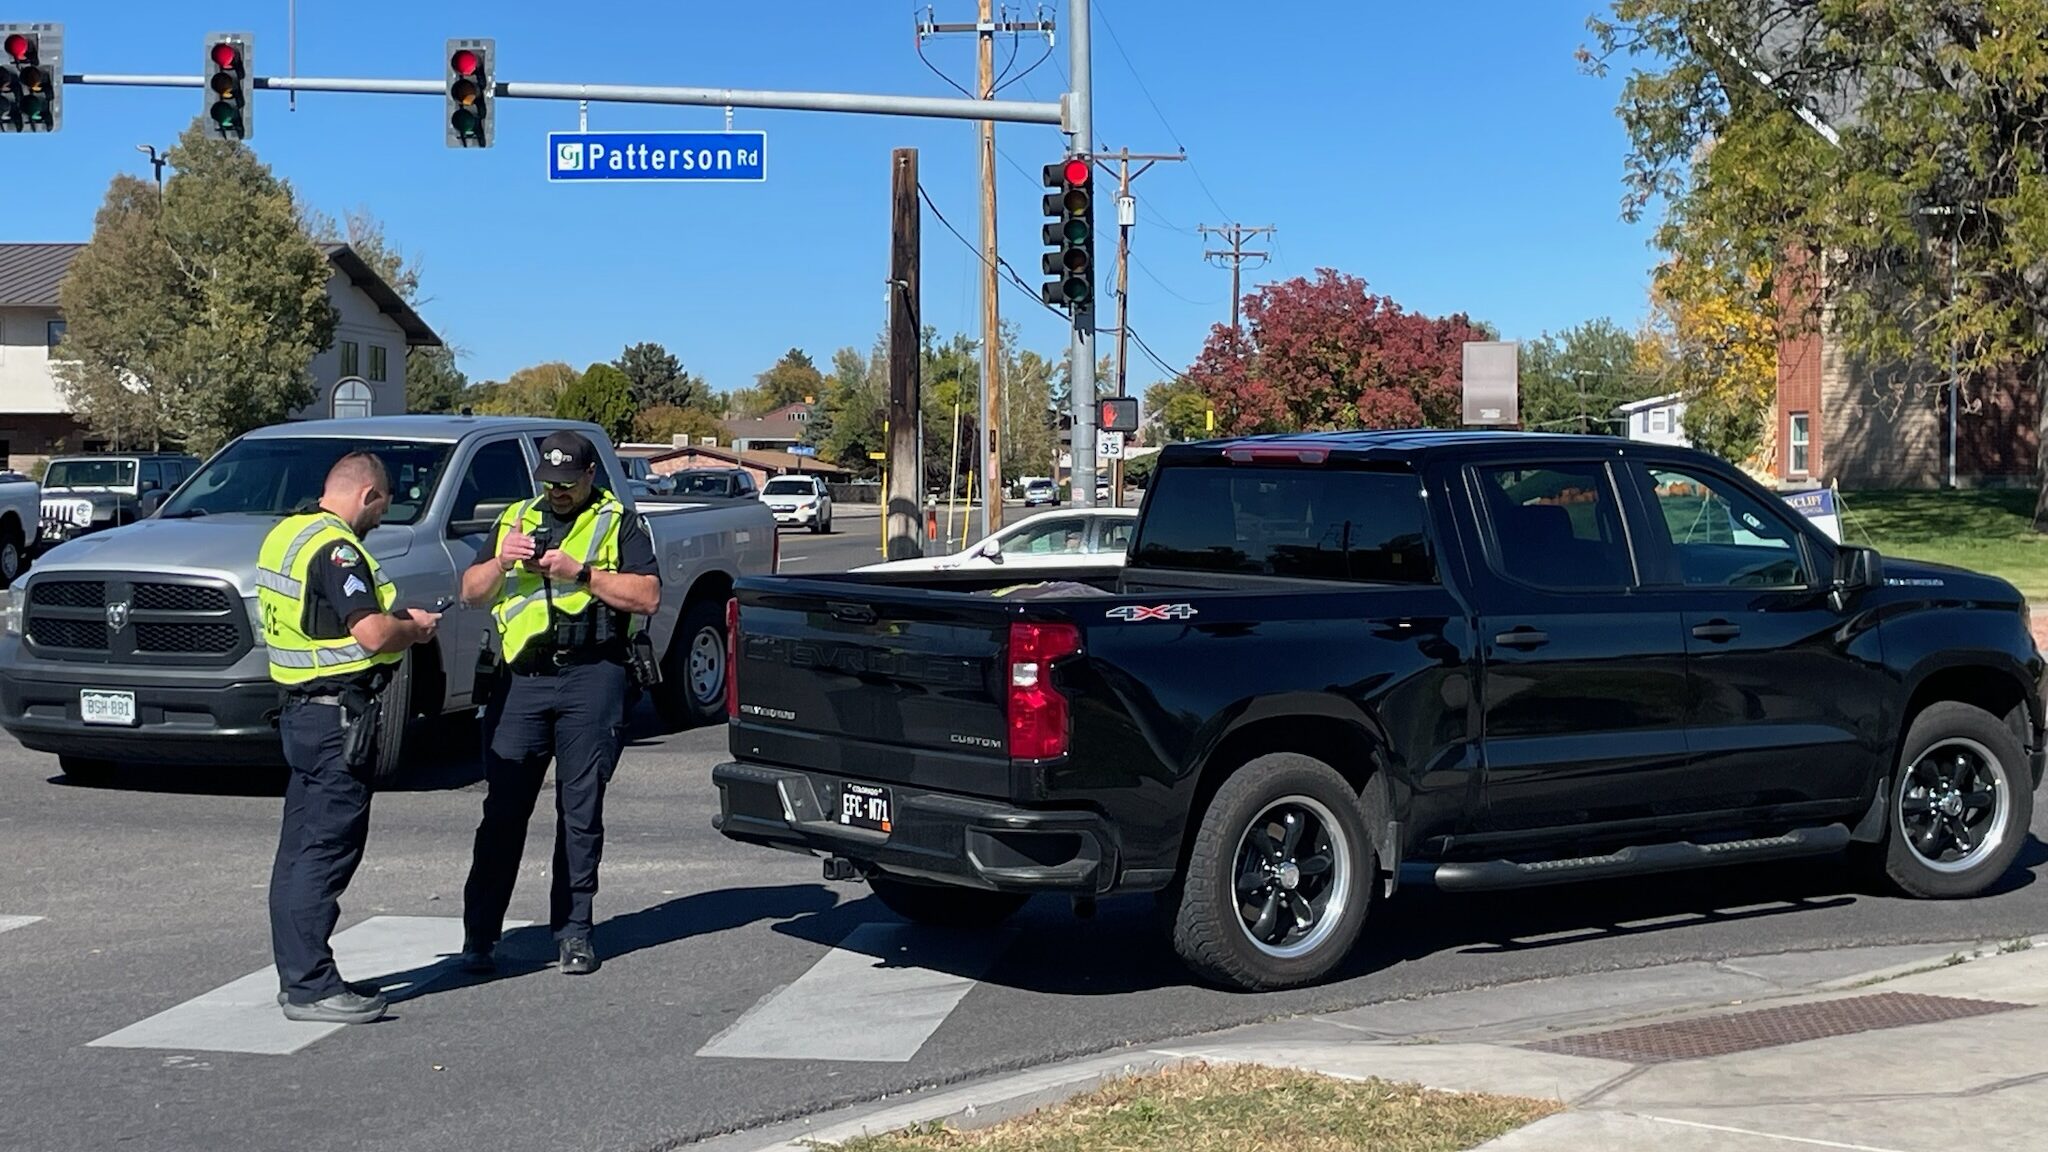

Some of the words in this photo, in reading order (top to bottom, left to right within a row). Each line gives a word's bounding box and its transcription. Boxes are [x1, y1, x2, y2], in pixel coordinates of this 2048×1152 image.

[589, 143, 732, 170] Patterson
[737, 149, 758, 166] Rd
[1100, 442, 1120, 455] 35
[950, 734, 1001, 748] CUSTOM
